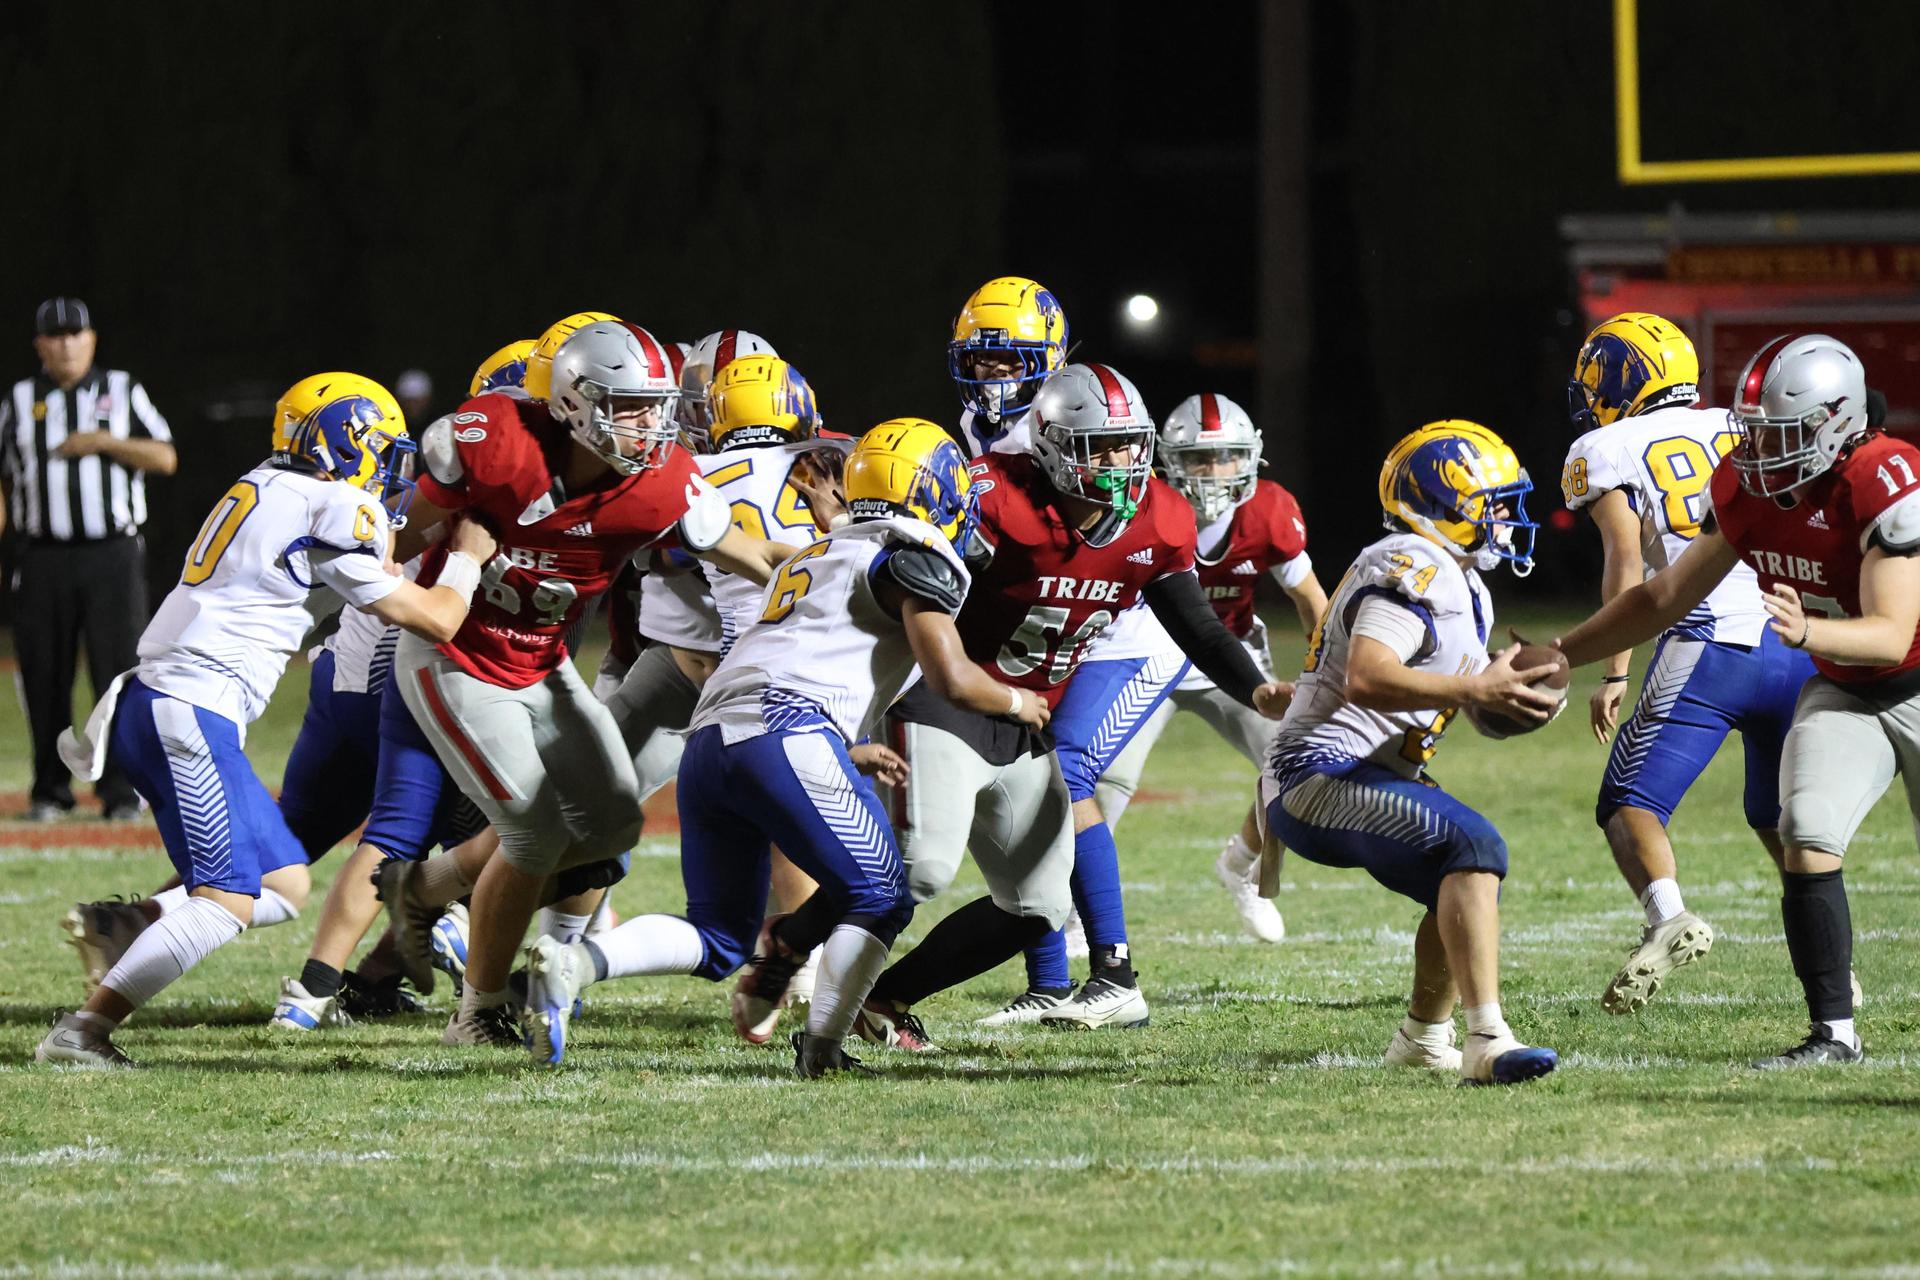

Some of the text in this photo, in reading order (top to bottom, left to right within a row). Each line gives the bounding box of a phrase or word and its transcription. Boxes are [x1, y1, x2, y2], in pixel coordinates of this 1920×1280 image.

[454, 411, 489, 443] 69
[733, 426, 772, 440] schutt
[853, 500, 888, 513] schutt
[180, 479, 260, 588] 0
[757, 538, 833, 625] 6
[1750, 550, 1828, 586] TRIBE
[479, 552, 578, 626] 69
[1037, 576, 1125, 603] TRIBE
